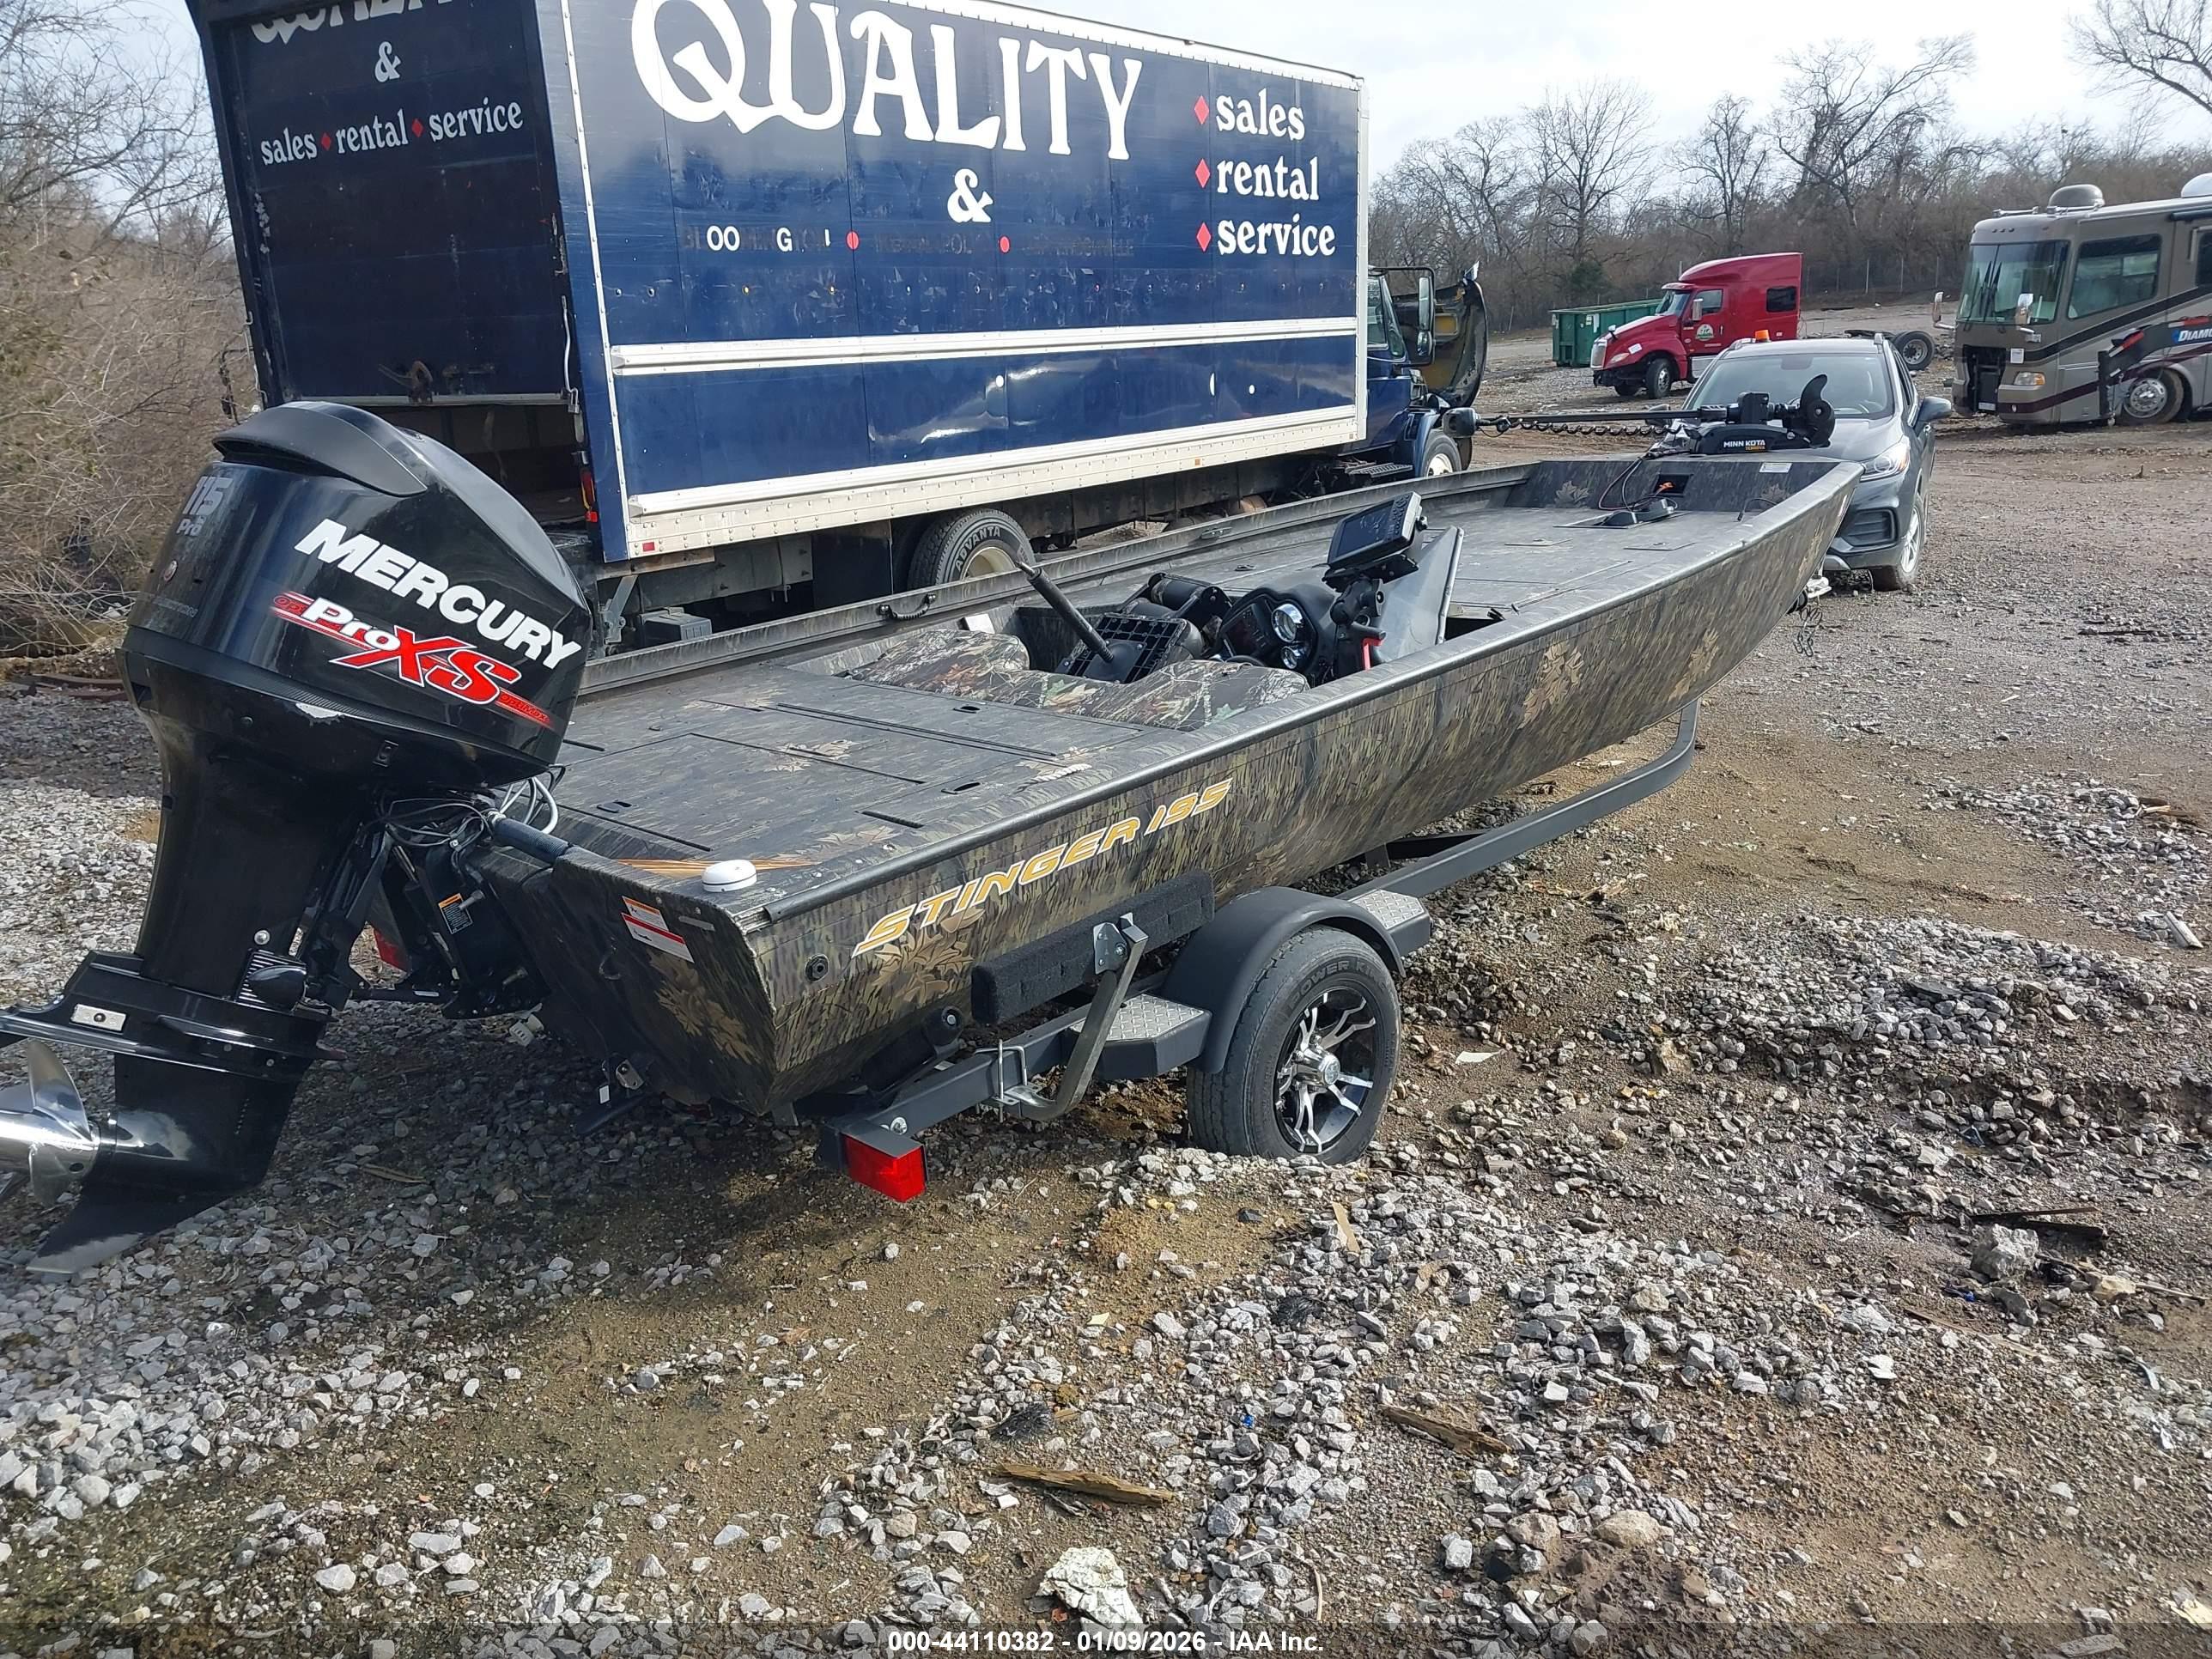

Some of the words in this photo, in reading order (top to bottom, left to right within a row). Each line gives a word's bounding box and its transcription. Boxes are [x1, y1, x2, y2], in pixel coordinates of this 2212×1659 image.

[374, 41, 401, 82] &
[631, 0, 1143, 161] QUALITY
[260, 129, 318, 166] sales
[335, 109, 408, 155] rental
[429, 96, 524, 143] service
[1216, 89, 1305, 142] sales
[947, 168, 994, 223] &
[1217, 156, 1319, 203] rental
[1217, 214, 1336, 256] service
[182, 476, 234, 515] 115
[954, 526, 1001, 571] ADVANTA
[295, 518, 582, 671] MERCURY
[852, 817, 1141, 958] STINGER
[1144, 777, 1234, 837] 195
[1289, 959, 1351, 1011] POWER
